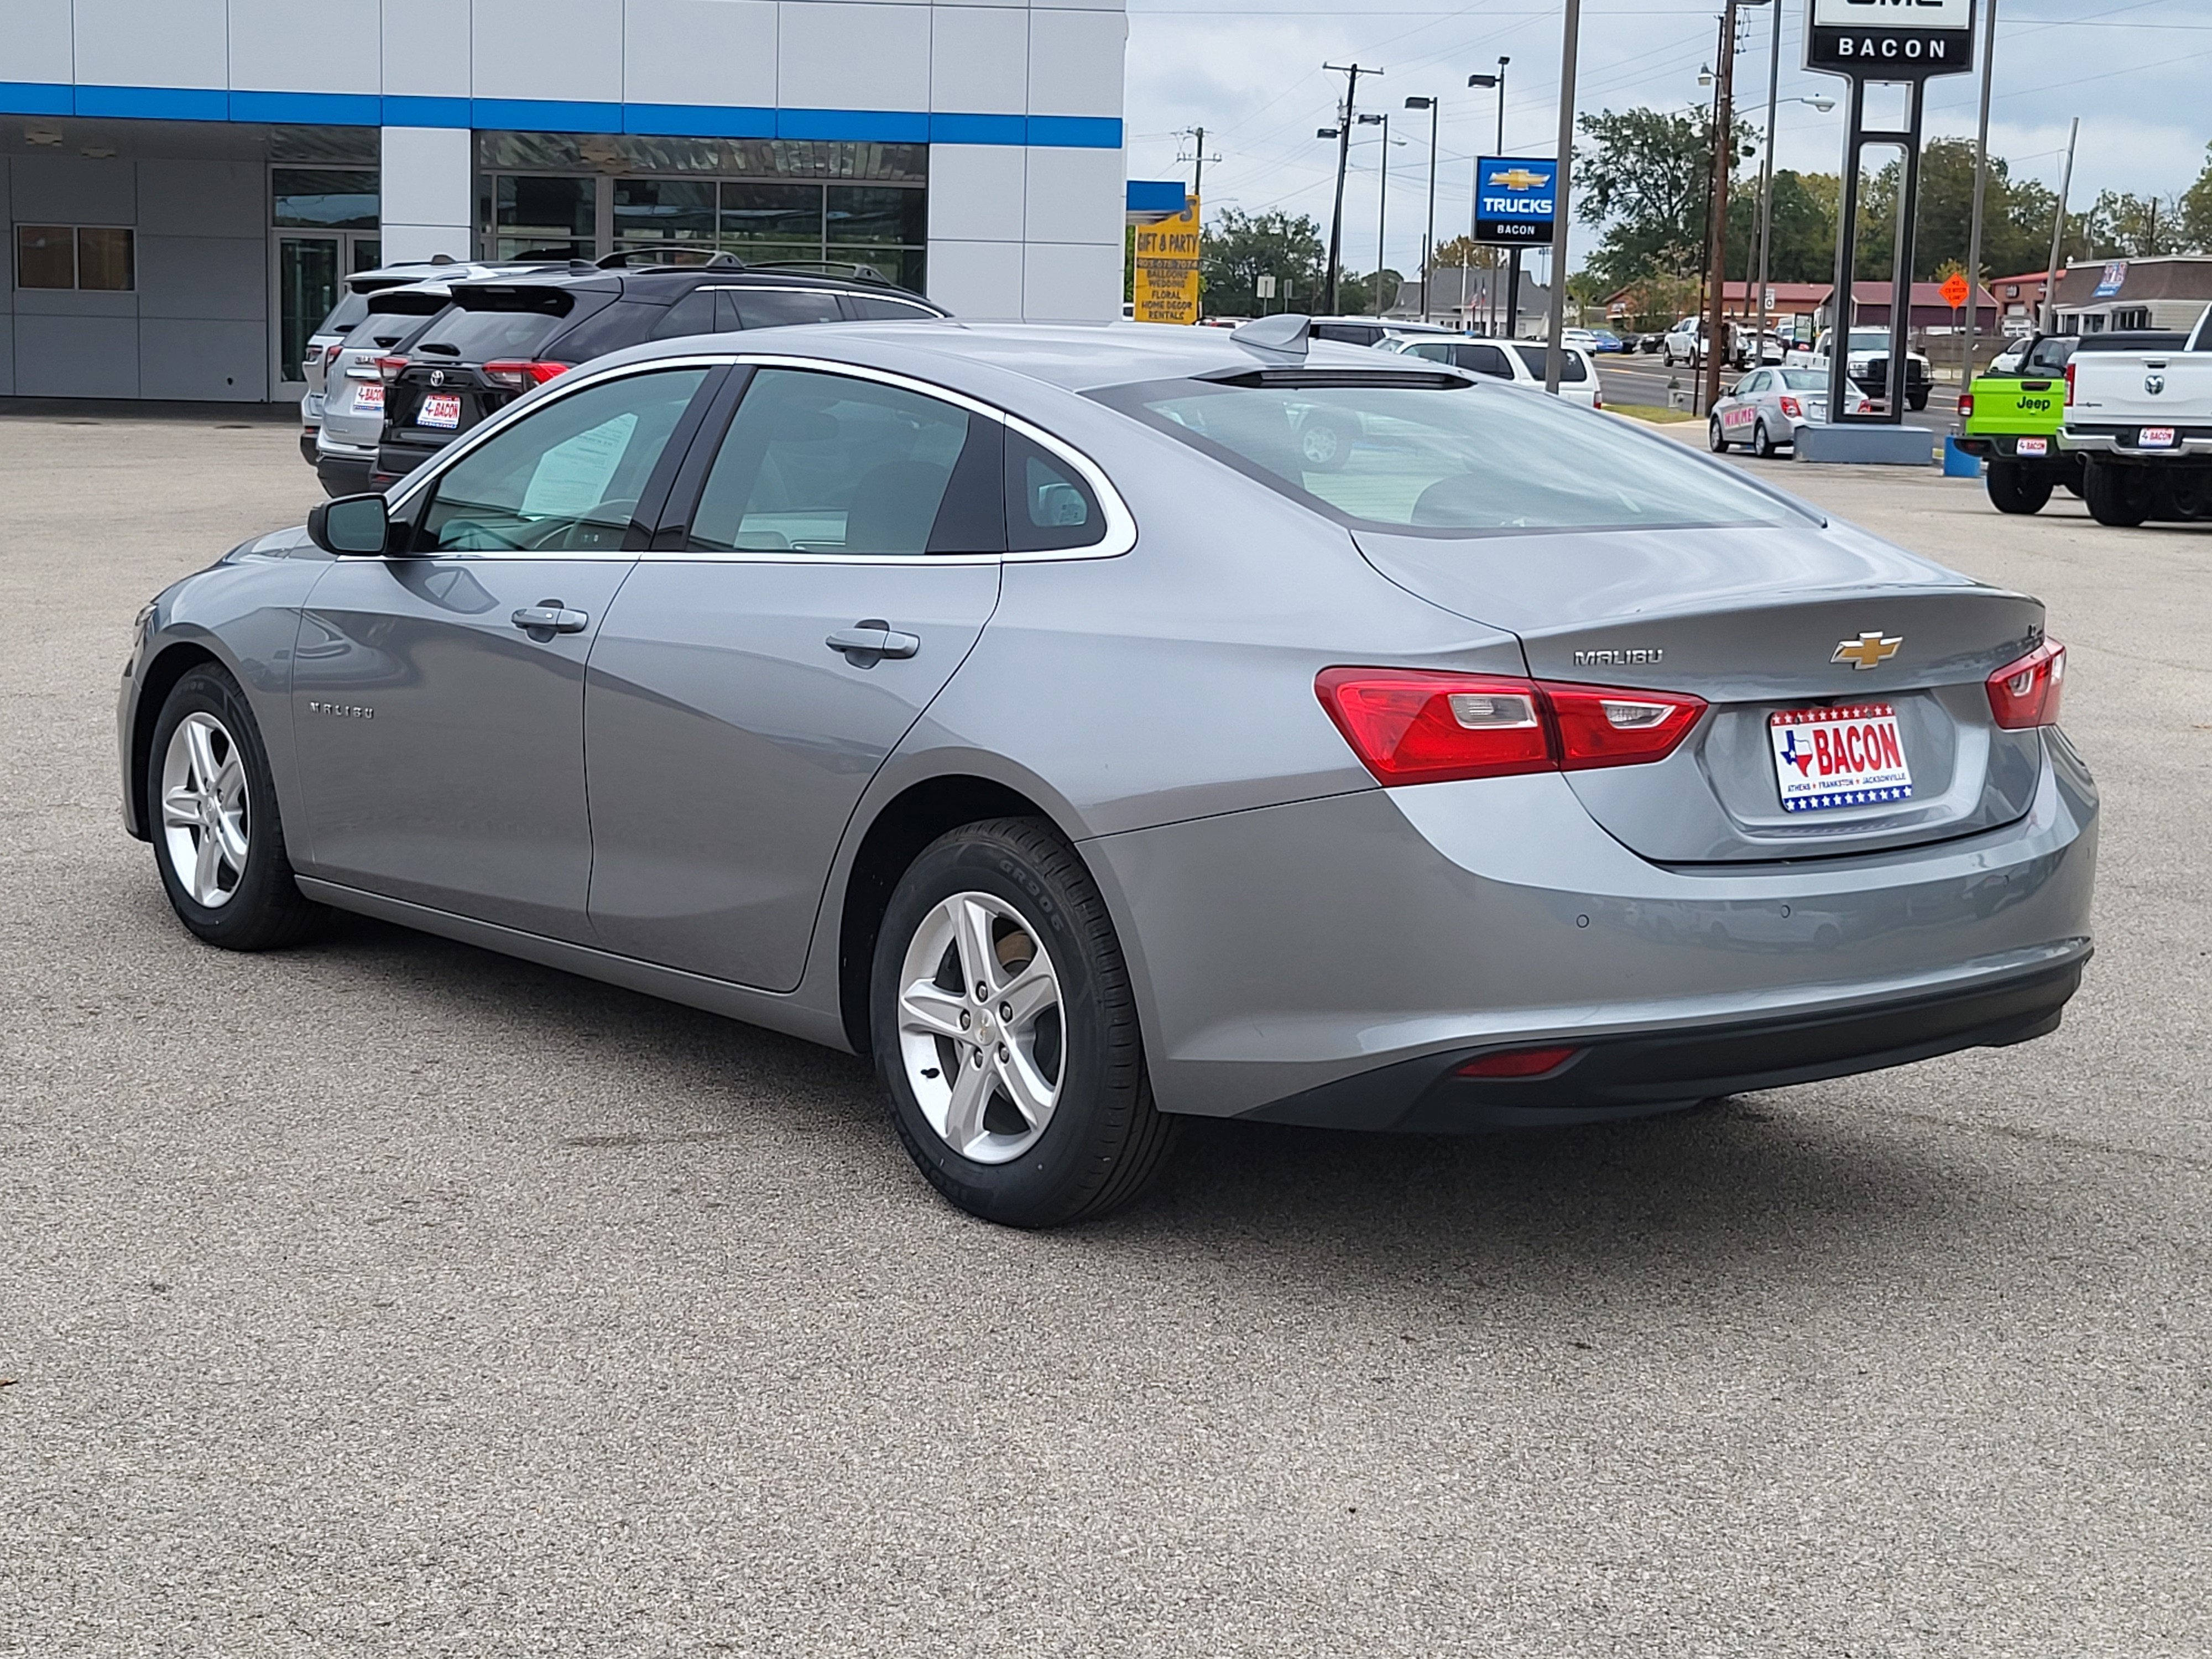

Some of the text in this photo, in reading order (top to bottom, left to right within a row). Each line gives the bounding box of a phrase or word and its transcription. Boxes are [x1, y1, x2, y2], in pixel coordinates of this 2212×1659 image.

[1838, 38, 1945, 58] BACON
[1483, 197, 1552, 214] TRUCKS
[1497, 224, 1535, 236] BACON
[1169, 234, 1198, 253] PARTY
[1152, 290, 1181, 299] FLORAL
[434, 402, 457, 418] BACON
[2017, 396, 2051, 411] Jeep
[2150, 431, 2172, 441] BACON
[1574, 649, 1663, 666] MALIBU
[310, 701, 374, 719] MALIBU
[1812, 723, 1902, 776] BACON
[1787, 772, 1907, 792] ATHENS FRANKSTON JACKSONVILLE
